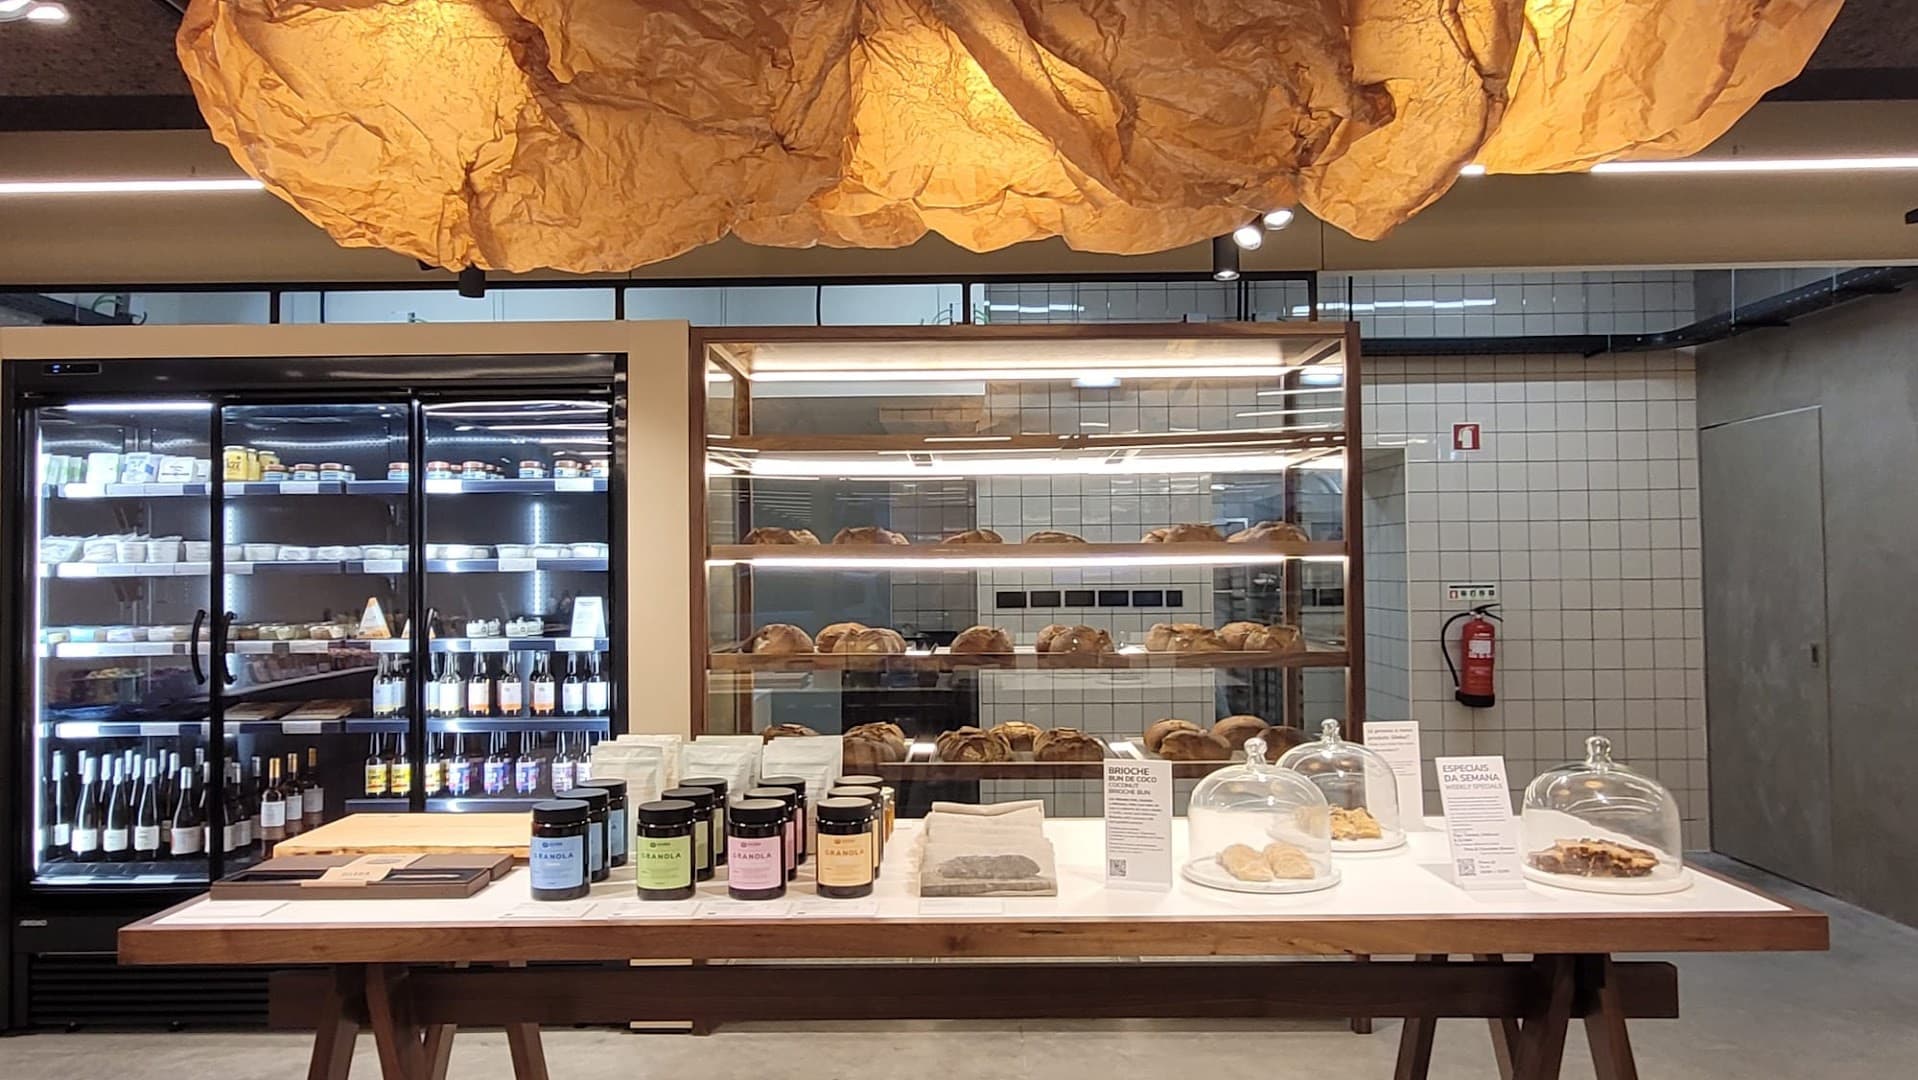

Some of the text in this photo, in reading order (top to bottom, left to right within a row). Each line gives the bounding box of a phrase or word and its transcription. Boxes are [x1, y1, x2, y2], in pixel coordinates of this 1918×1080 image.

[1108, 767, 1150, 775] BRIOCHE
[1442, 764, 1489, 773] ESPECIAIS
[1444, 773, 1500, 782] DA SEMANA
[824, 848, 864, 857] GRANOLA
